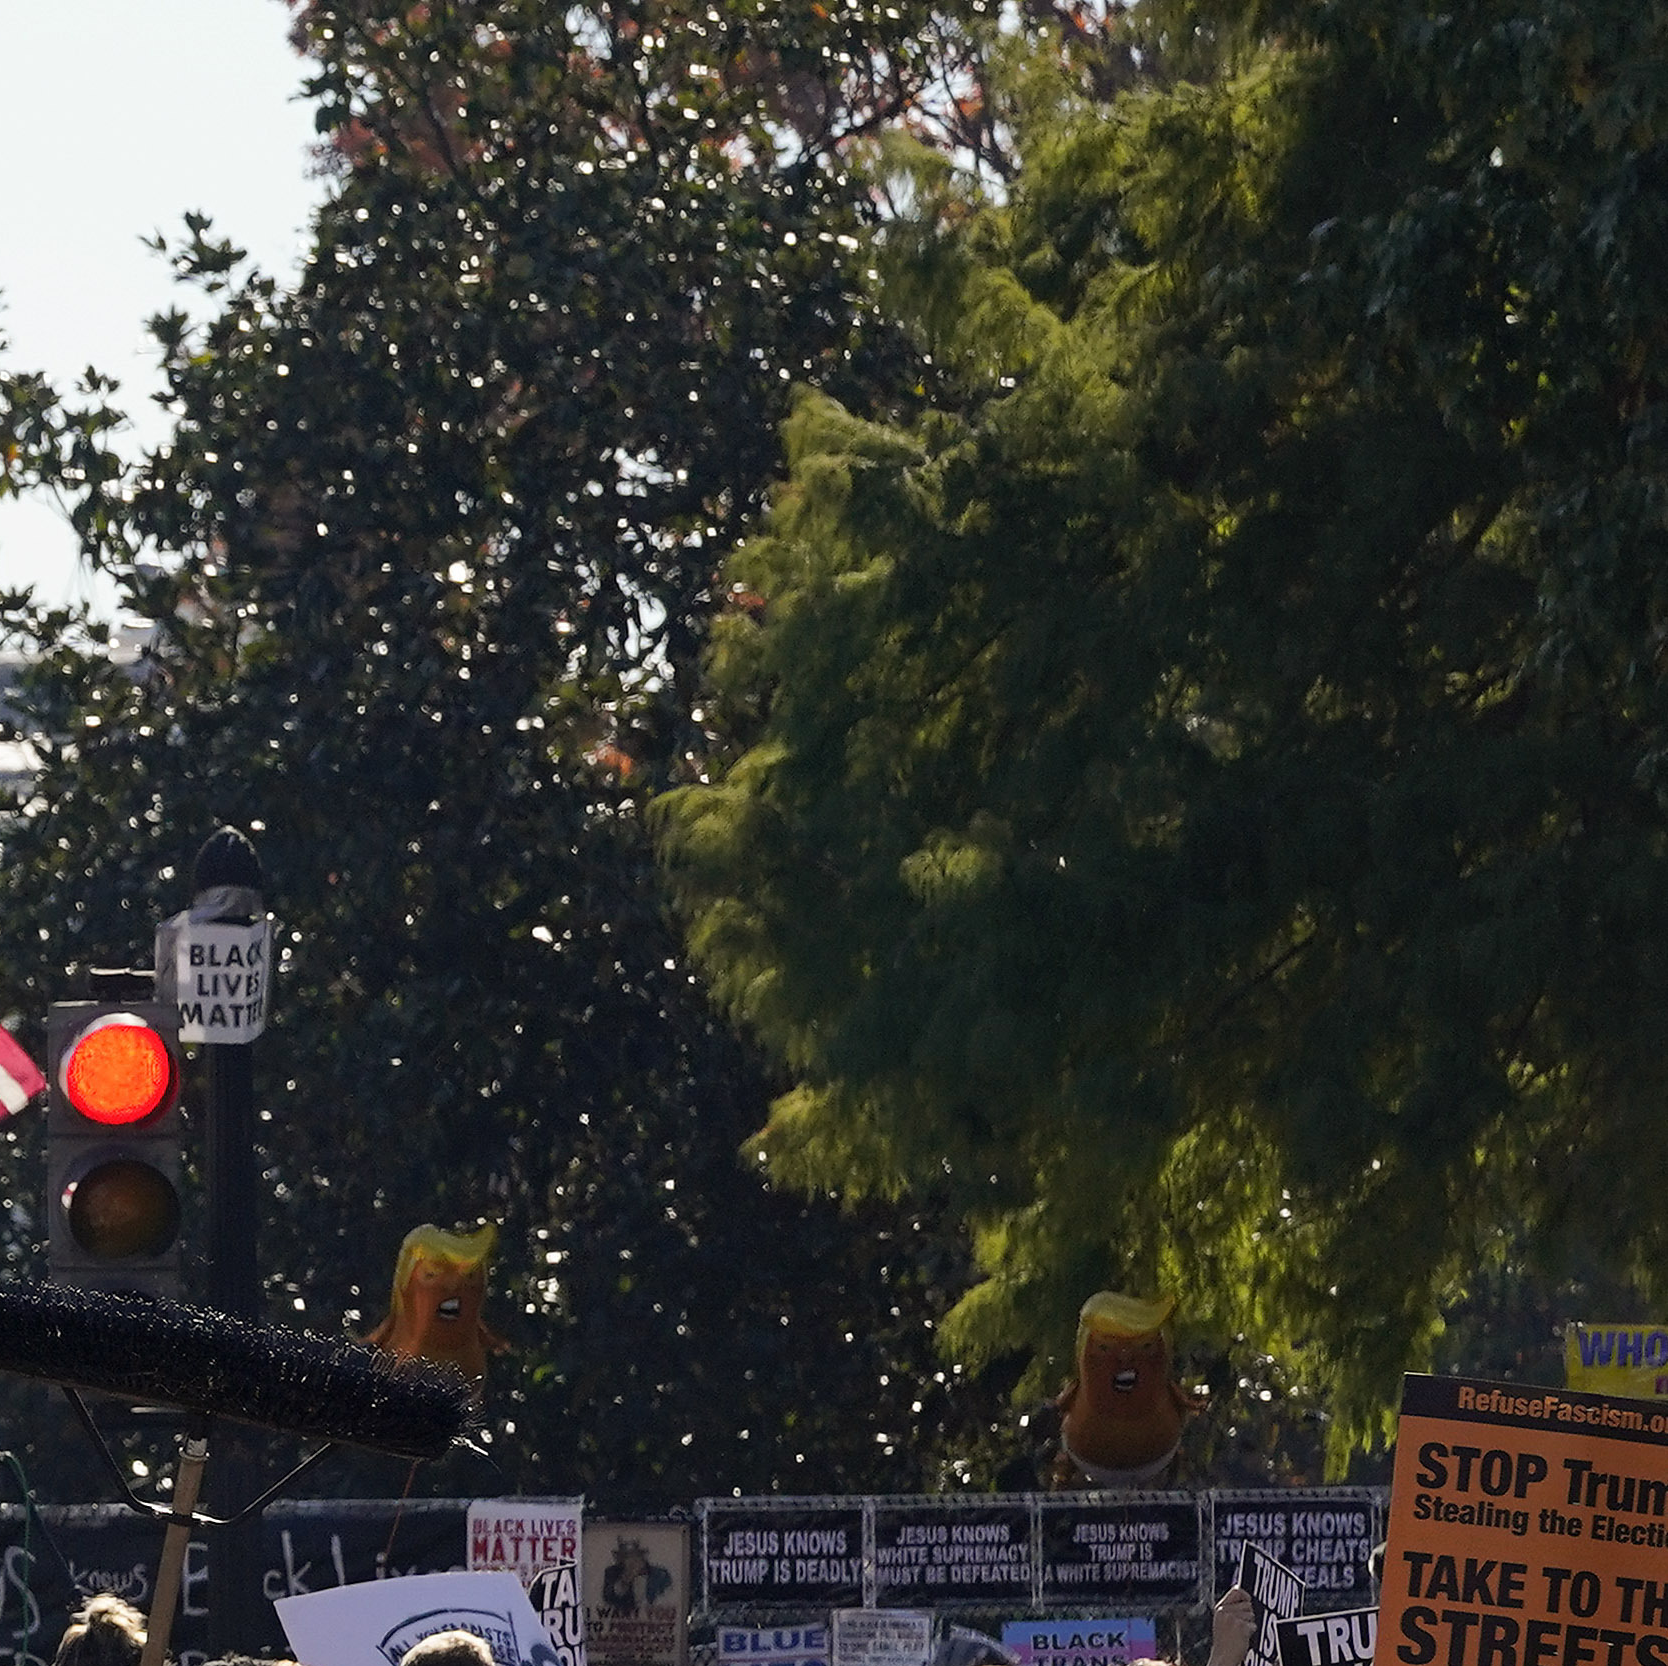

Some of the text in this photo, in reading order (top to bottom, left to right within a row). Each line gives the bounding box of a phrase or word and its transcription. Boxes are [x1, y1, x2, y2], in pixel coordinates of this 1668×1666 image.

[1458, 1386, 1668, 1434] RefuseFascism.o
[1416, 1441, 1668, 1517] STOP Trum
[472, 1518, 577, 1537] BLACK LIVES
[895, 1524, 1011, 1545] JESUS KNOWS
[1072, 1522, 1170, 1544] JESUS KNOWS
[1221, 1511, 1367, 1538] JESUS KNOWS
[1413, 1493, 1668, 1549] Stealing the Electi
[471, 1536, 577, 1563] MATTER
[722, 1529, 848, 1557] JESUS KNOWS
[876, 1543, 1030, 1565] WHITE SUPREMACY
[1088, 1543, 1153, 1563] TRUMP IS
[1216, 1537, 1370, 1564] TRMP CHEATS
[708, 1556, 862, 1585] TRUMP IS DEADLY
[875, 1561, 1031, 1586] MUST BE DEFEATED
[1044, 1564, 1054, 1583] A
[1055, 1562, 1101, 1584] WHITE
[1103, 1560, 1199, 1582] SUPREMACIST
[1296, 1563, 1356, 1590] EALS
[1253, 1551, 1301, 1619] TRUMP
[1403, 1550, 1668, 1628] TAKE TO TH
[723, 1630, 826, 1653] BLUE
[1031, 1630, 1127, 1650] BLACK
